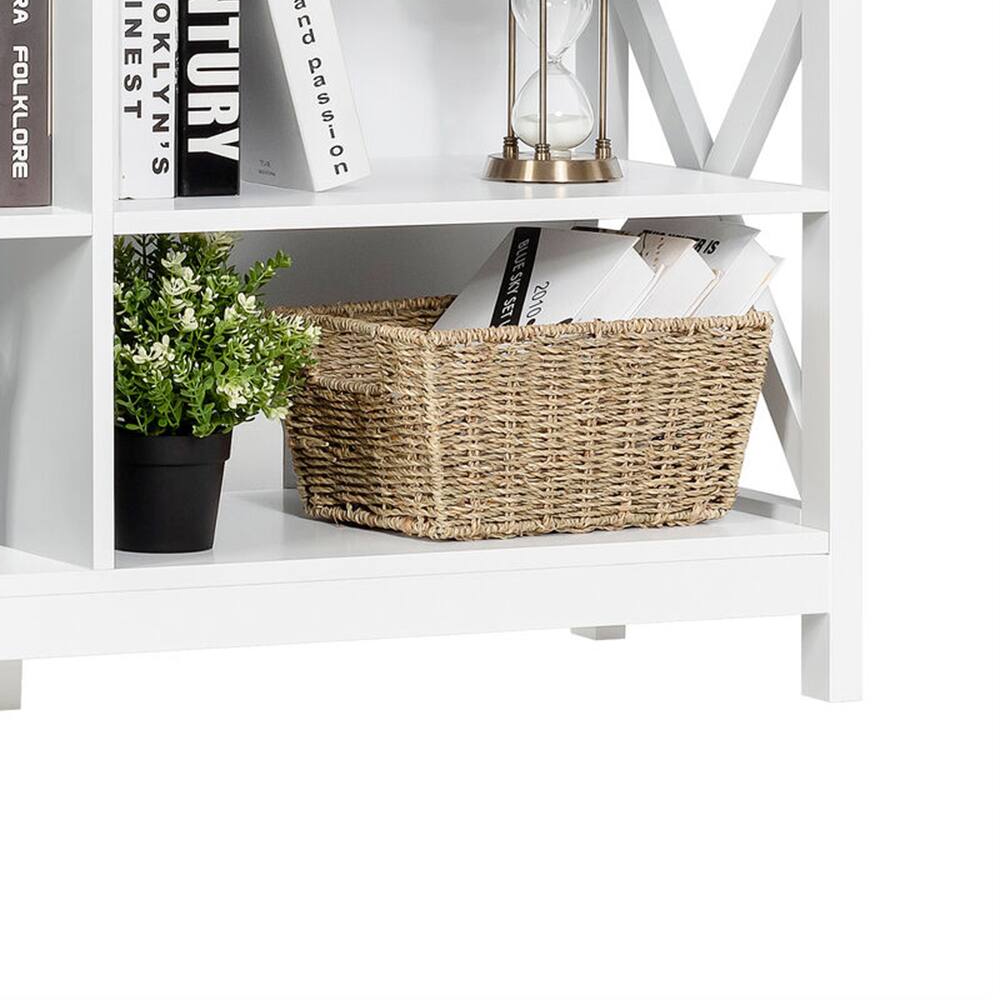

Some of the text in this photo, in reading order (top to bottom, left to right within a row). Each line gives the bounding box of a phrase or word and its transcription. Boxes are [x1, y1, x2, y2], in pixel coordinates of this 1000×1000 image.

[12, 46, 29, 179] FOLKLORE
[308, 57, 348, 175] passion
[512, 238, 530, 272] BLUE
[506, 272, 523, 295] SKY
[500, 296, 517, 319] SET
